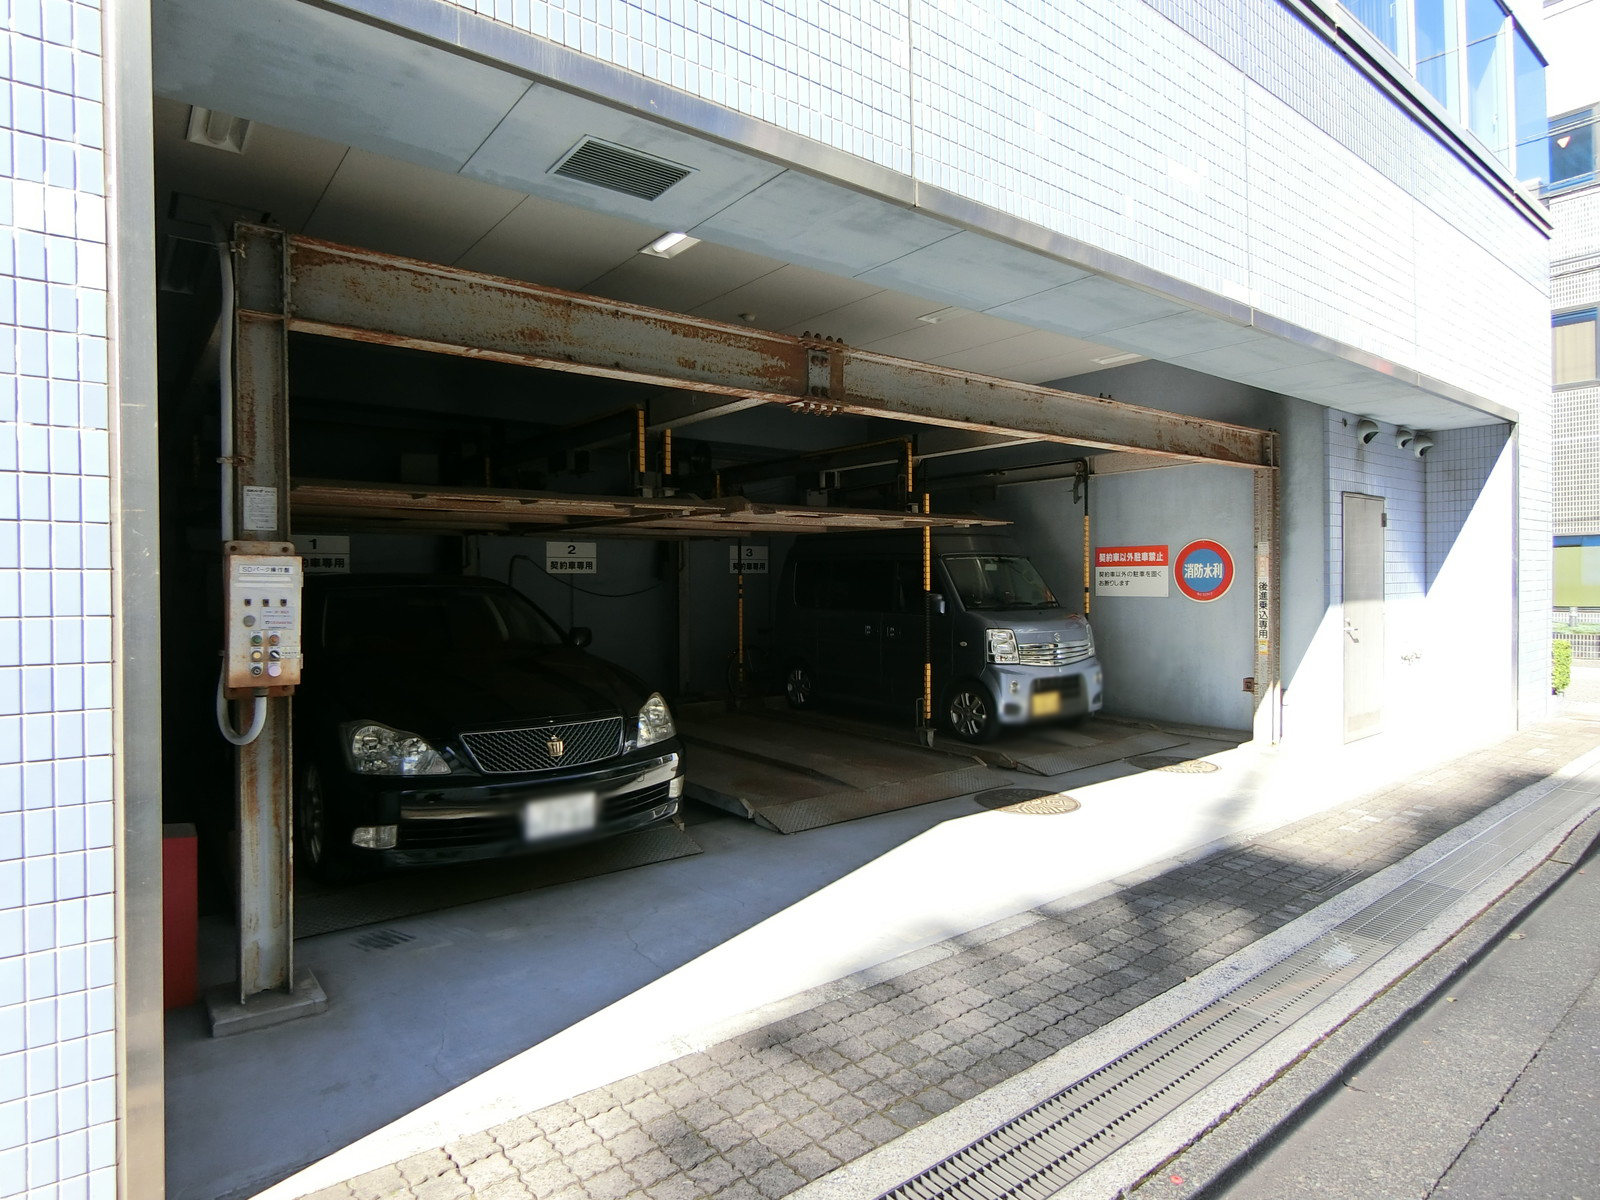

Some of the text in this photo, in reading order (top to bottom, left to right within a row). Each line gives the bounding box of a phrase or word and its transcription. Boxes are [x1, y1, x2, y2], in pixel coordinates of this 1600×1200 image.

[309, 538, 316, 549] 1
[567, 545, 576, 554] 2
[746, 548, 752, 557] 3
[1099, 551, 1163, 562] 契約車以外駐車禁止
[550, 561, 593, 570] 契約車専用
[1184, 562, 1223, 579] 消防水利
[1098, 570, 1162, 578] 契約車以外の駐車を固く
[1258, 581, 1268, 639] 後進乗込専用
